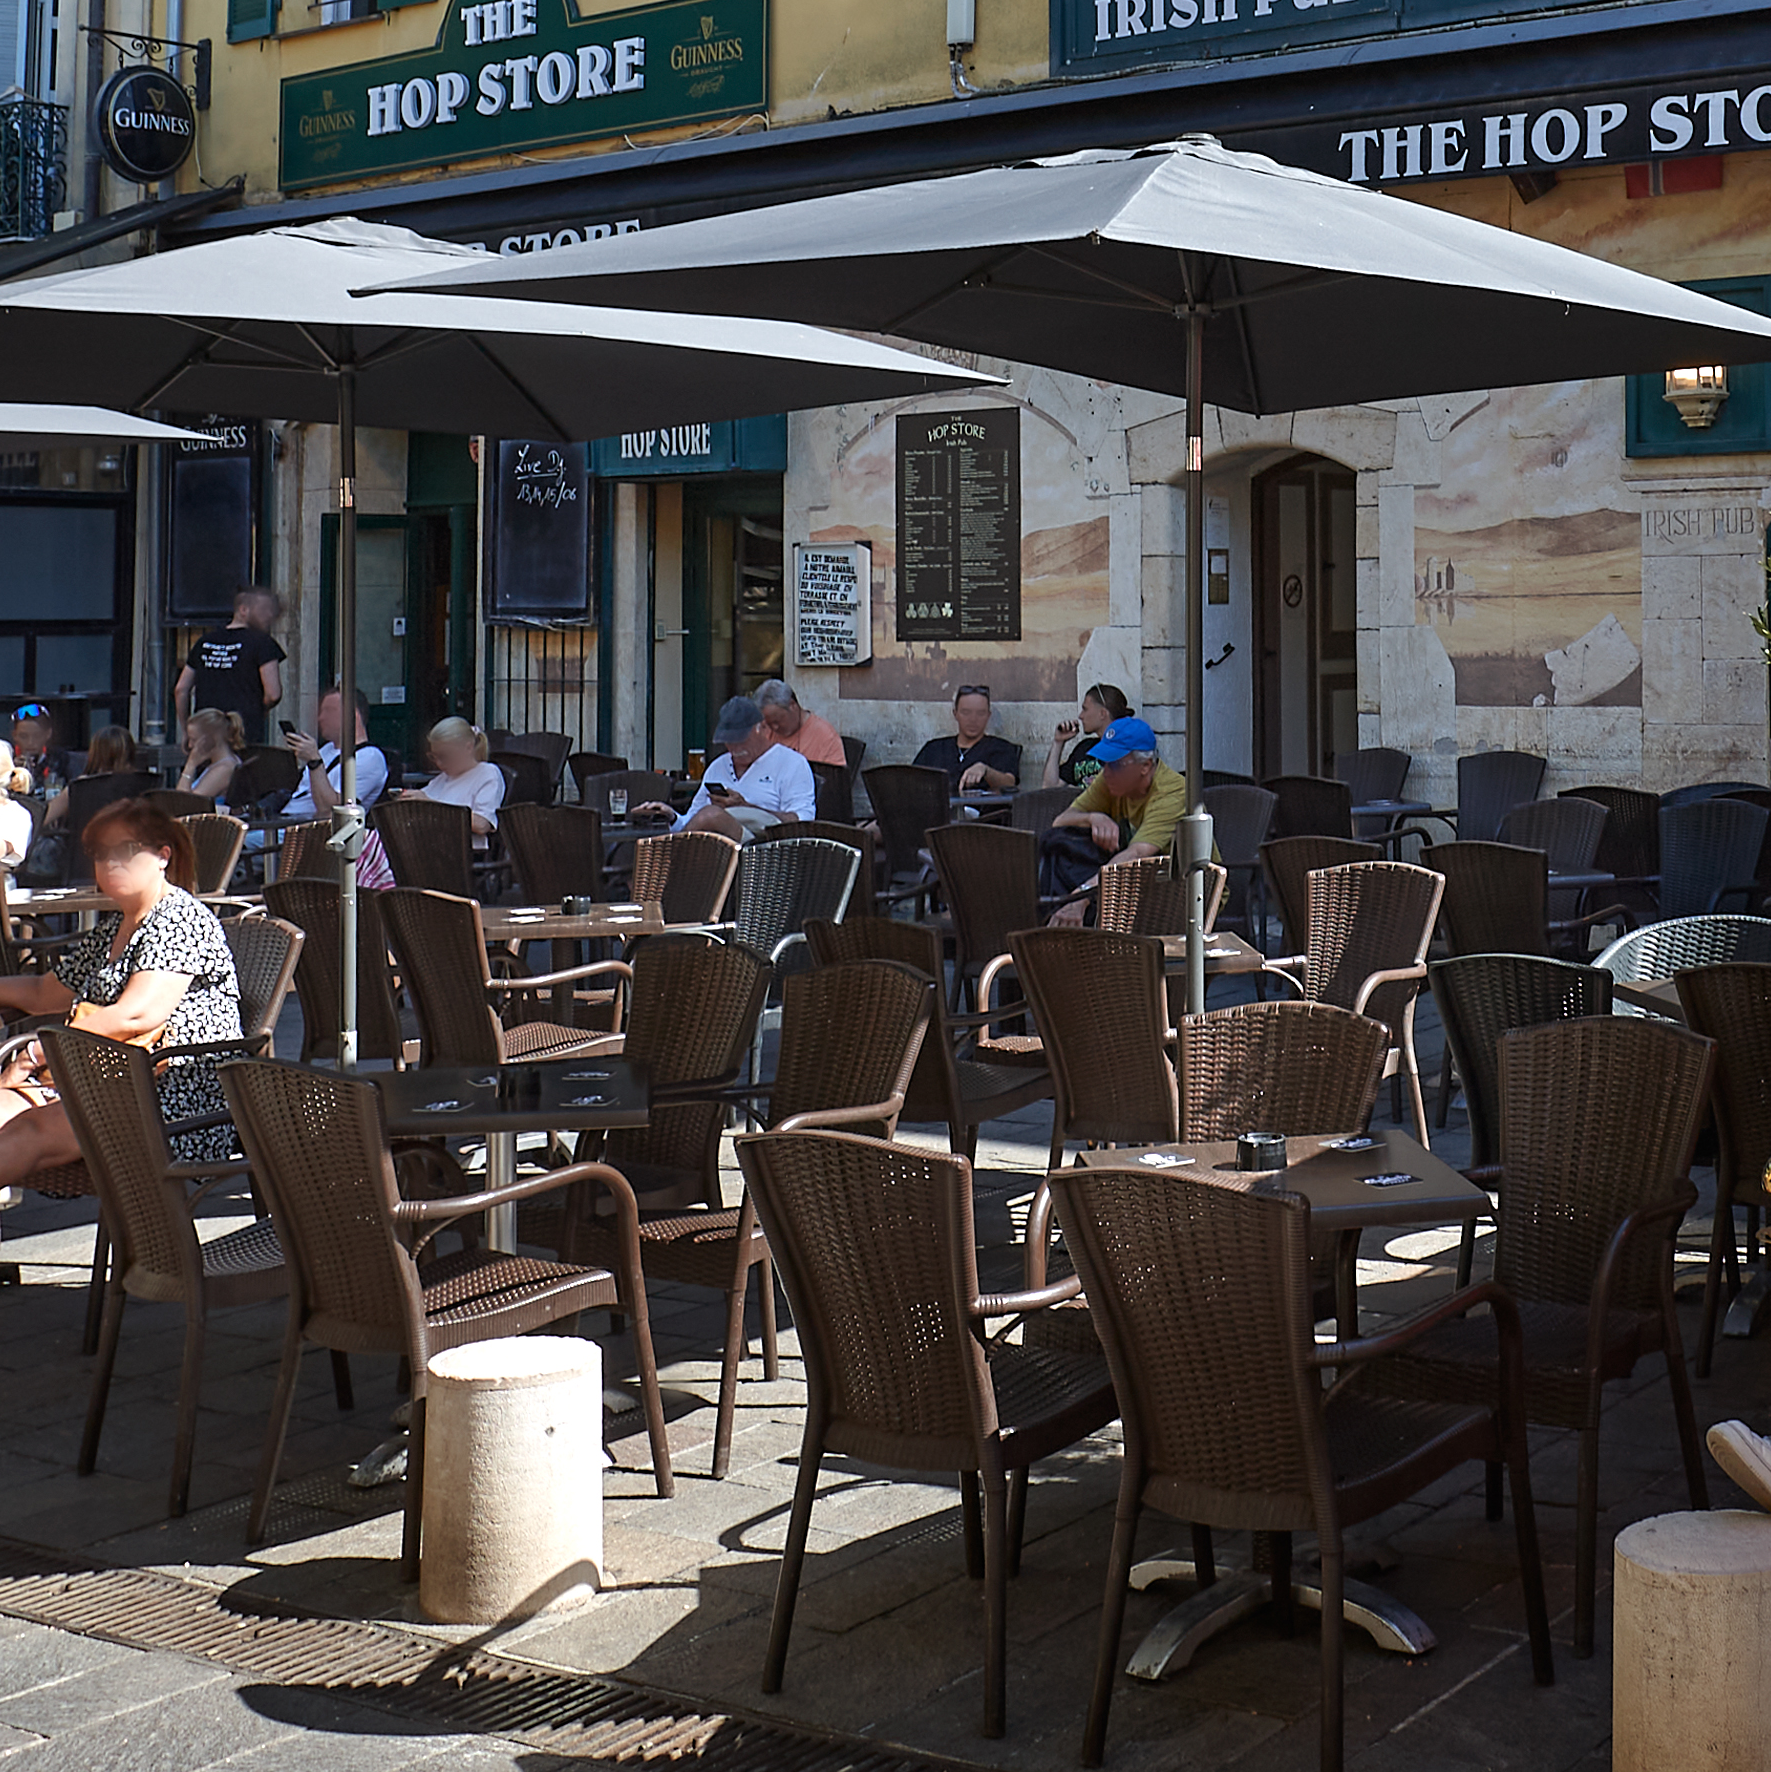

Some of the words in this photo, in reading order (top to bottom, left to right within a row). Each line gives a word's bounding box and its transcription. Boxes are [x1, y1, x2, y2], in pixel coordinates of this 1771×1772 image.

[670, 37, 744, 71] GUINNESS
[365, 70, 470, 139] HOP
[476, 35, 646, 118] STORE
[114, 106, 190, 138] GUINNESS
[299, 109, 356, 138] GUINNESS
[1338, 118, 1469, 183] THE
[1481, 102, 1628, 170] HOP
[927, 423, 949, 443] HOP
[951, 422, 986, 440] STORE
[514, 444, 542, 475] Live
[1645, 508, 1701, 545] IRISH
[1712, 506, 1755, 535] PUB
